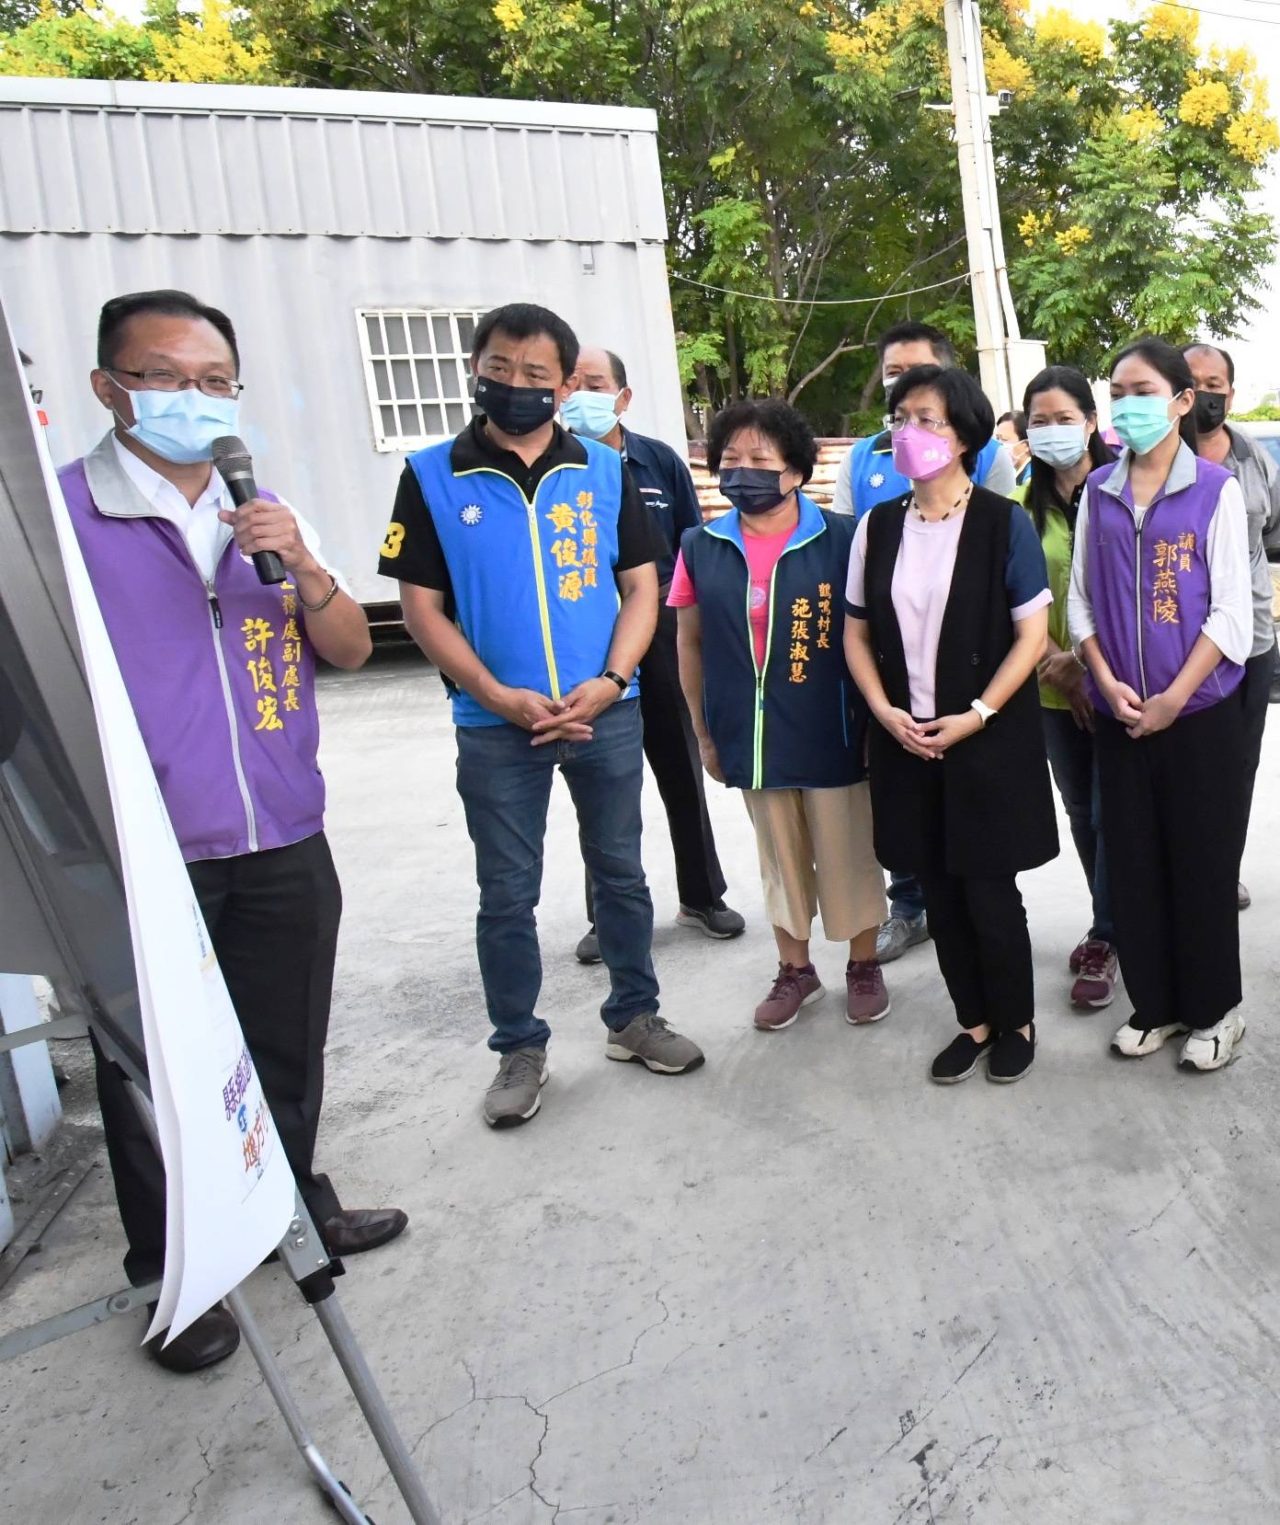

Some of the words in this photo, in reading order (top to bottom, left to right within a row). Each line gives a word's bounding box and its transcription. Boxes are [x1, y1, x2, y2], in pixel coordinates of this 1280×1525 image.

[379, 522, 405, 559] 3
[545, 503, 584, 602] 黃俊源
[1153, 539, 1180, 625] 郭燕陵
[1178, 532, 1196, 573] 議員
[240, 617, 284, 730] 許俊宏
[788, 597, 813, 683] 施張淑慧
